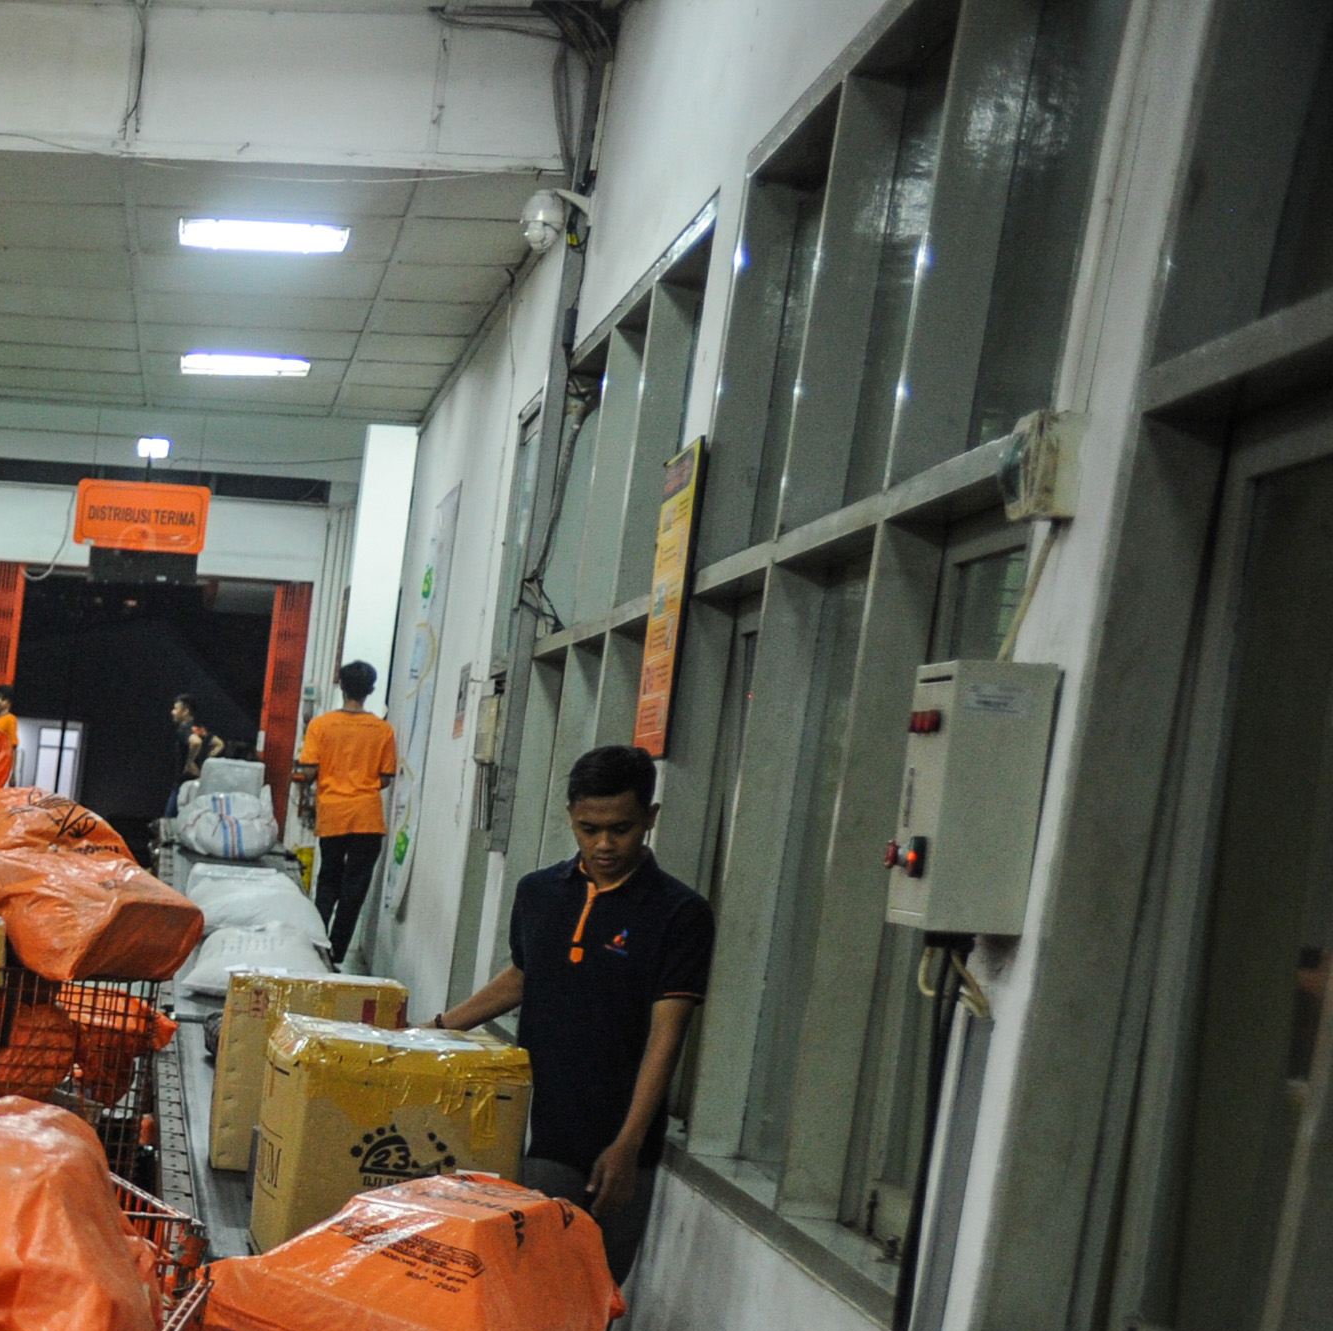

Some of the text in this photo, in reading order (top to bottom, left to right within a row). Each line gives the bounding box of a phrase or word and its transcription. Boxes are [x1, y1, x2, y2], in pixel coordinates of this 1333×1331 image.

[88, 505, 196, 526] DISTRIBUSI TERIMA
[370, 1145, 412, 1171] 23
